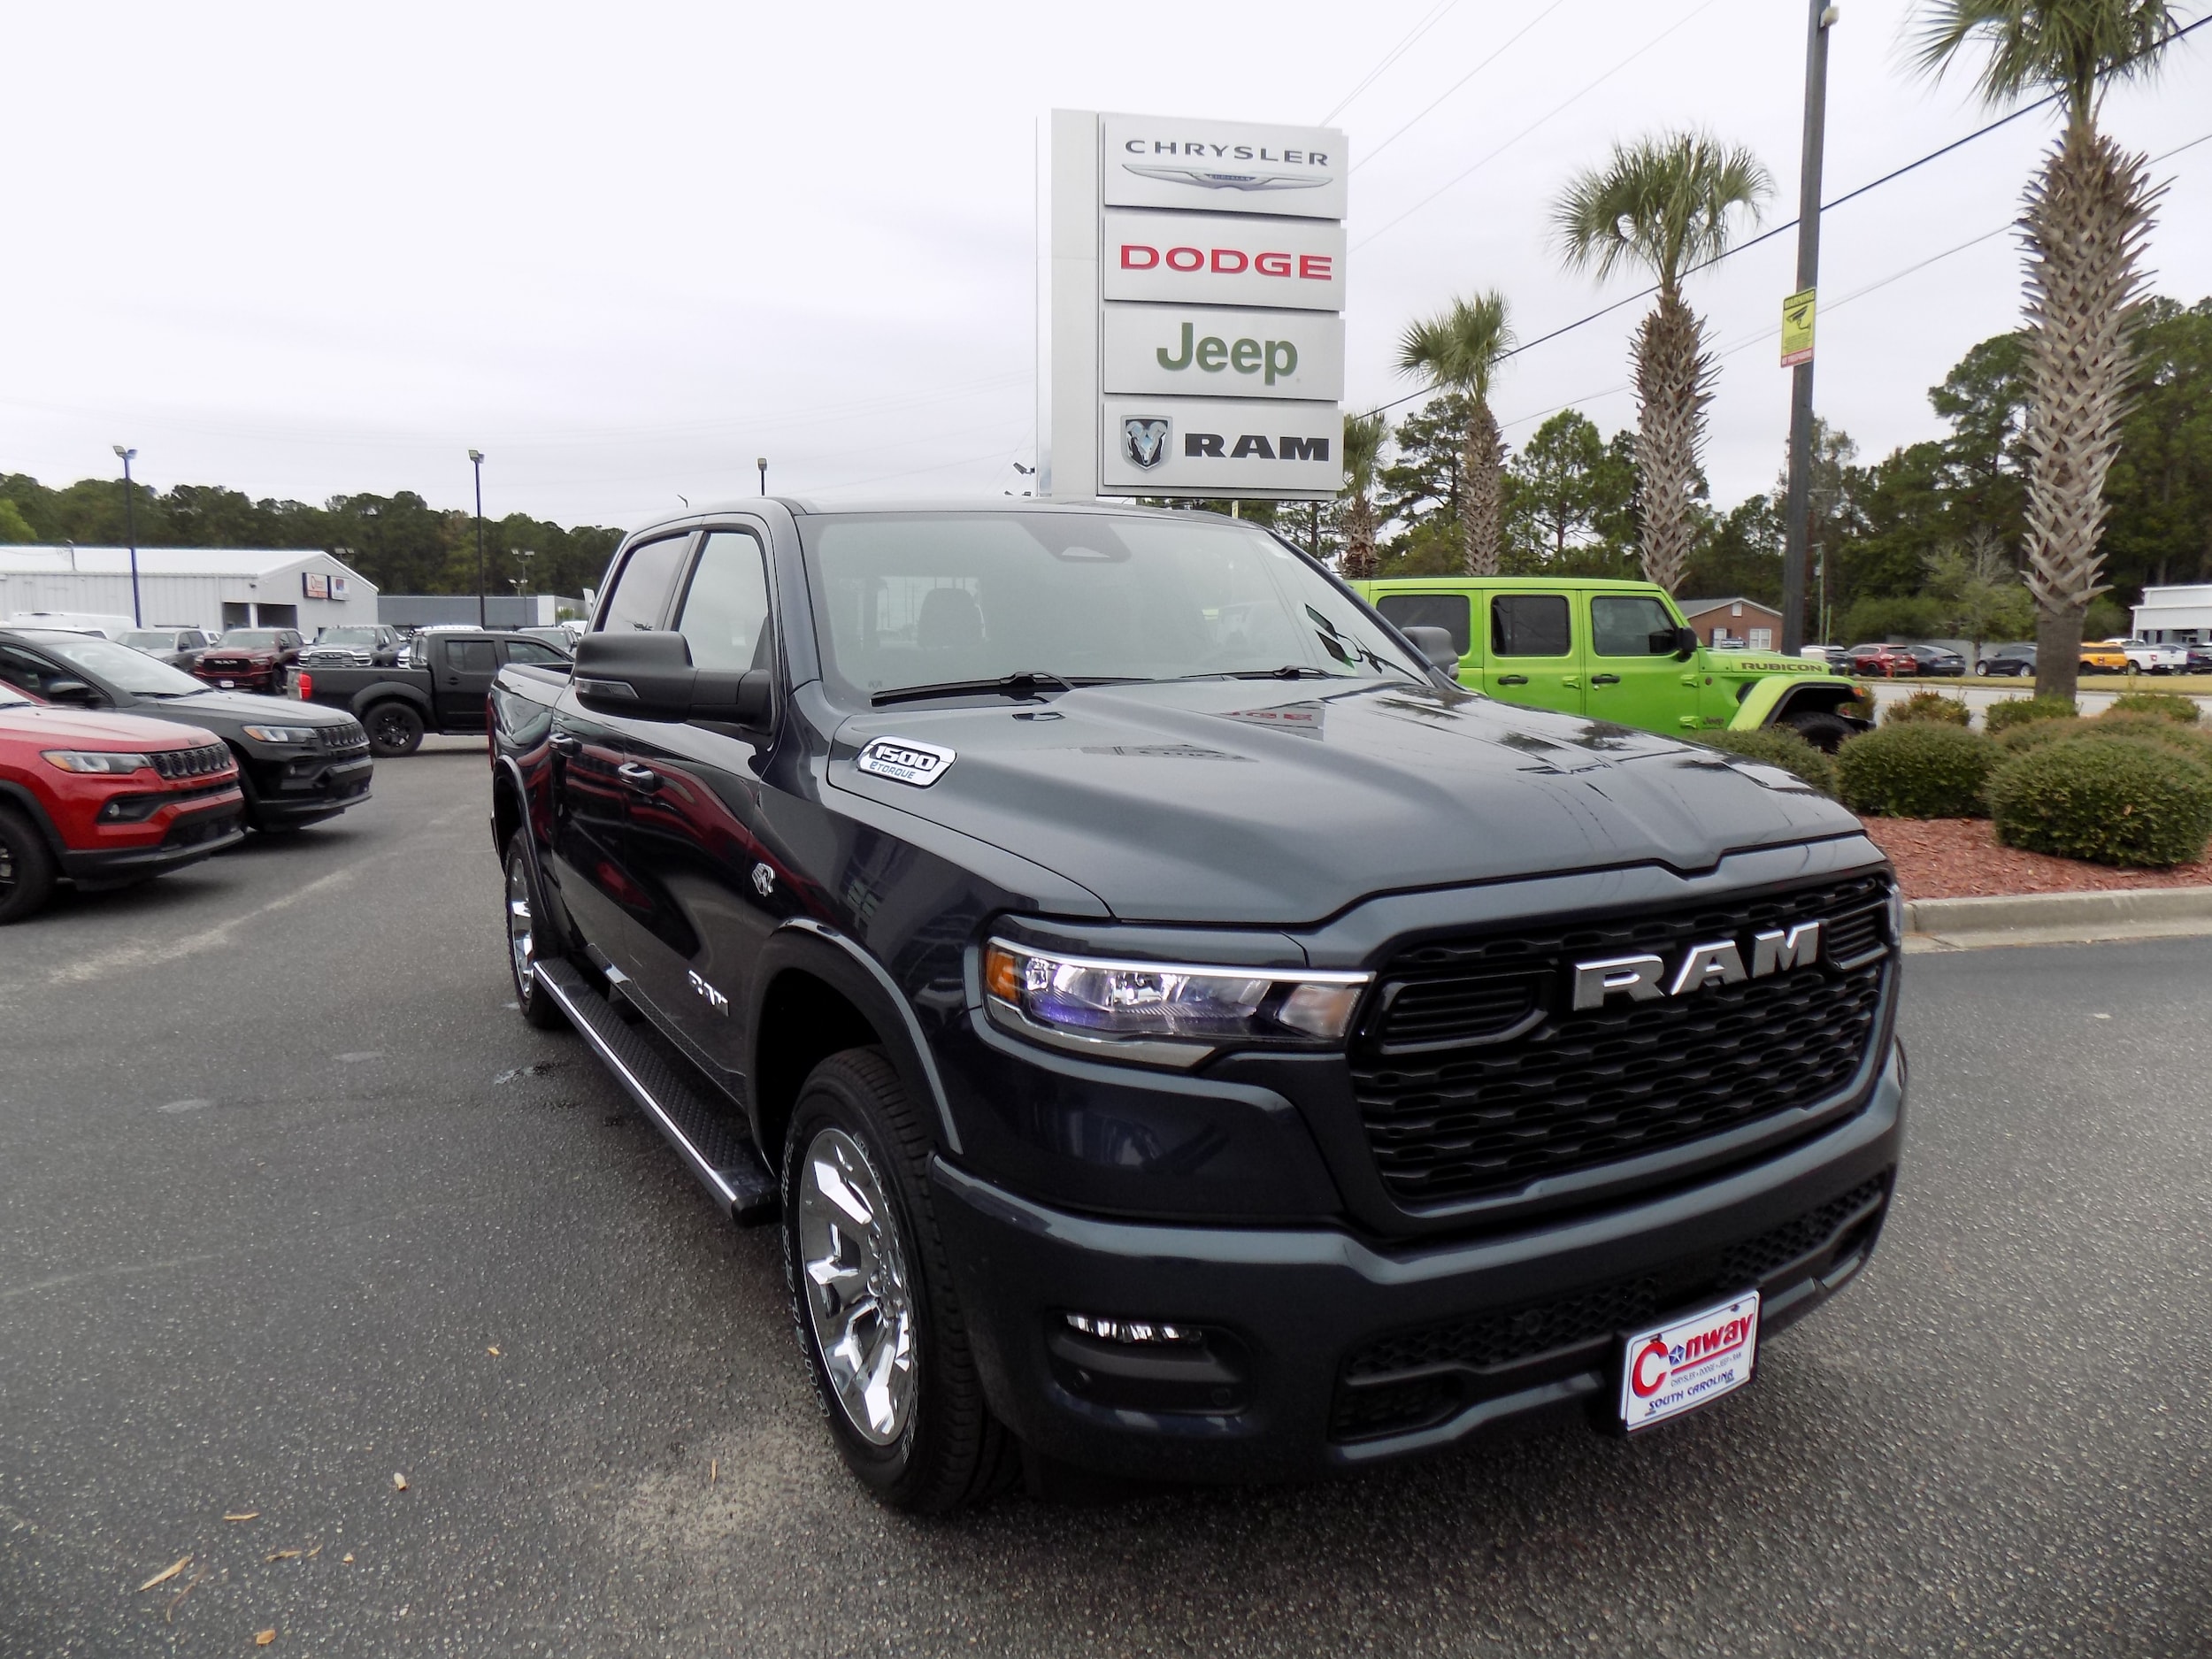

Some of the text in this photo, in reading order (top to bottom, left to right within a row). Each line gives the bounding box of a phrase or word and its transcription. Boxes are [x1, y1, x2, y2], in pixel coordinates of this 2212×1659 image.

[1125, 139, 1330, 166] CHRYSLER
[1120, 244, 1333, 281] DODGE
[1156, 321, 1299, 386] Jeep
[1184, 432, 1330, 462] RAM
[1740, 662, 1823, 672] RUBICON
[875, 745, 938, 771] 1500
[1572, 921, 1820, 1011] RAM
[1648, 1368, 1735, 1410] SOUTH CAROLINA
